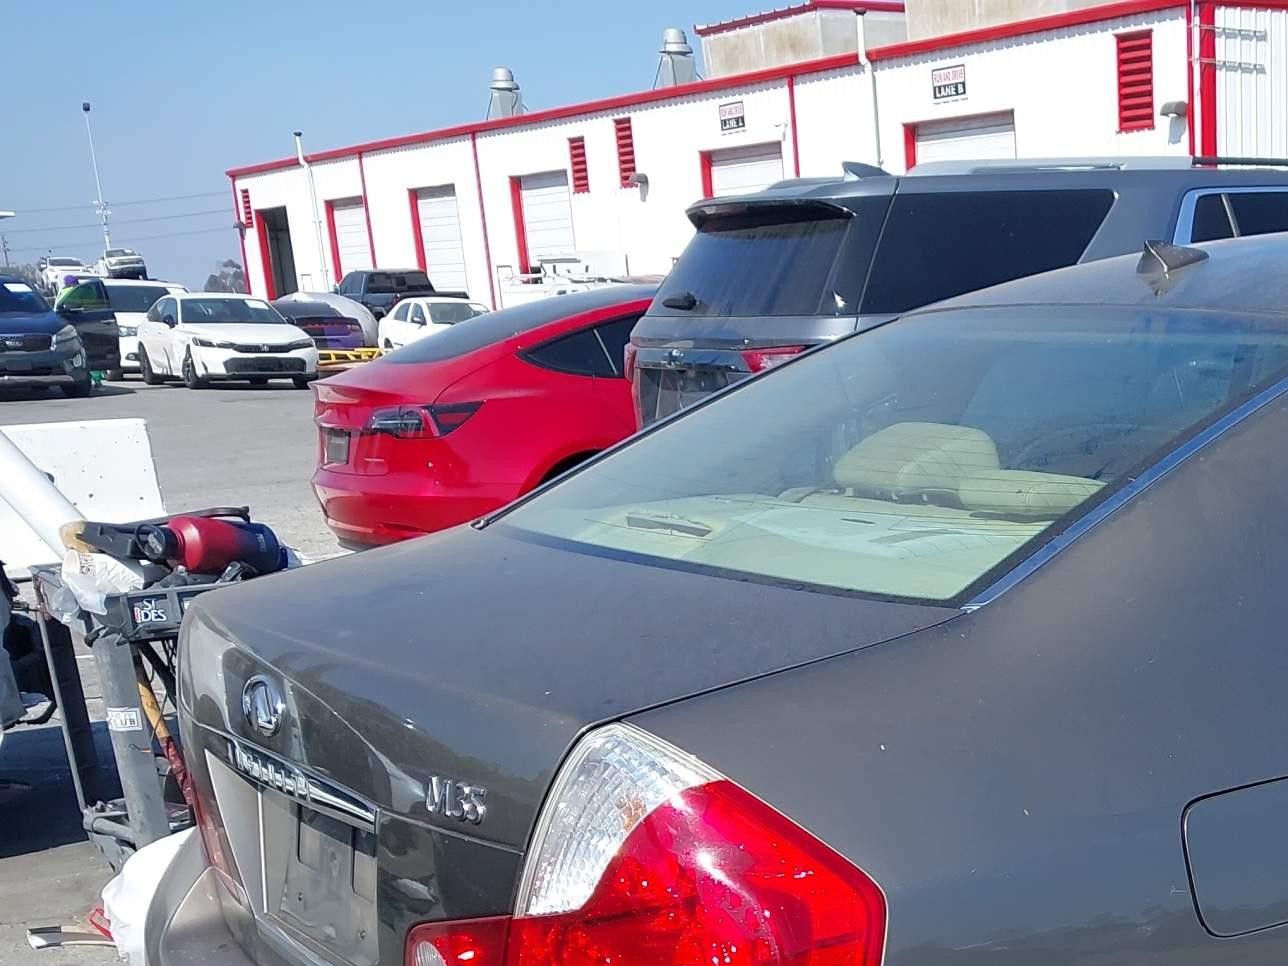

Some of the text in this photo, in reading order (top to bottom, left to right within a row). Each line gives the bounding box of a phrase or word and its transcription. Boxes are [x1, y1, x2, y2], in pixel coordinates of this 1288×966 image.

[935, 83, 964, 97] LANE B
[723, 118, 737, 129] LANE
[425, 775, 487, 823] M35
